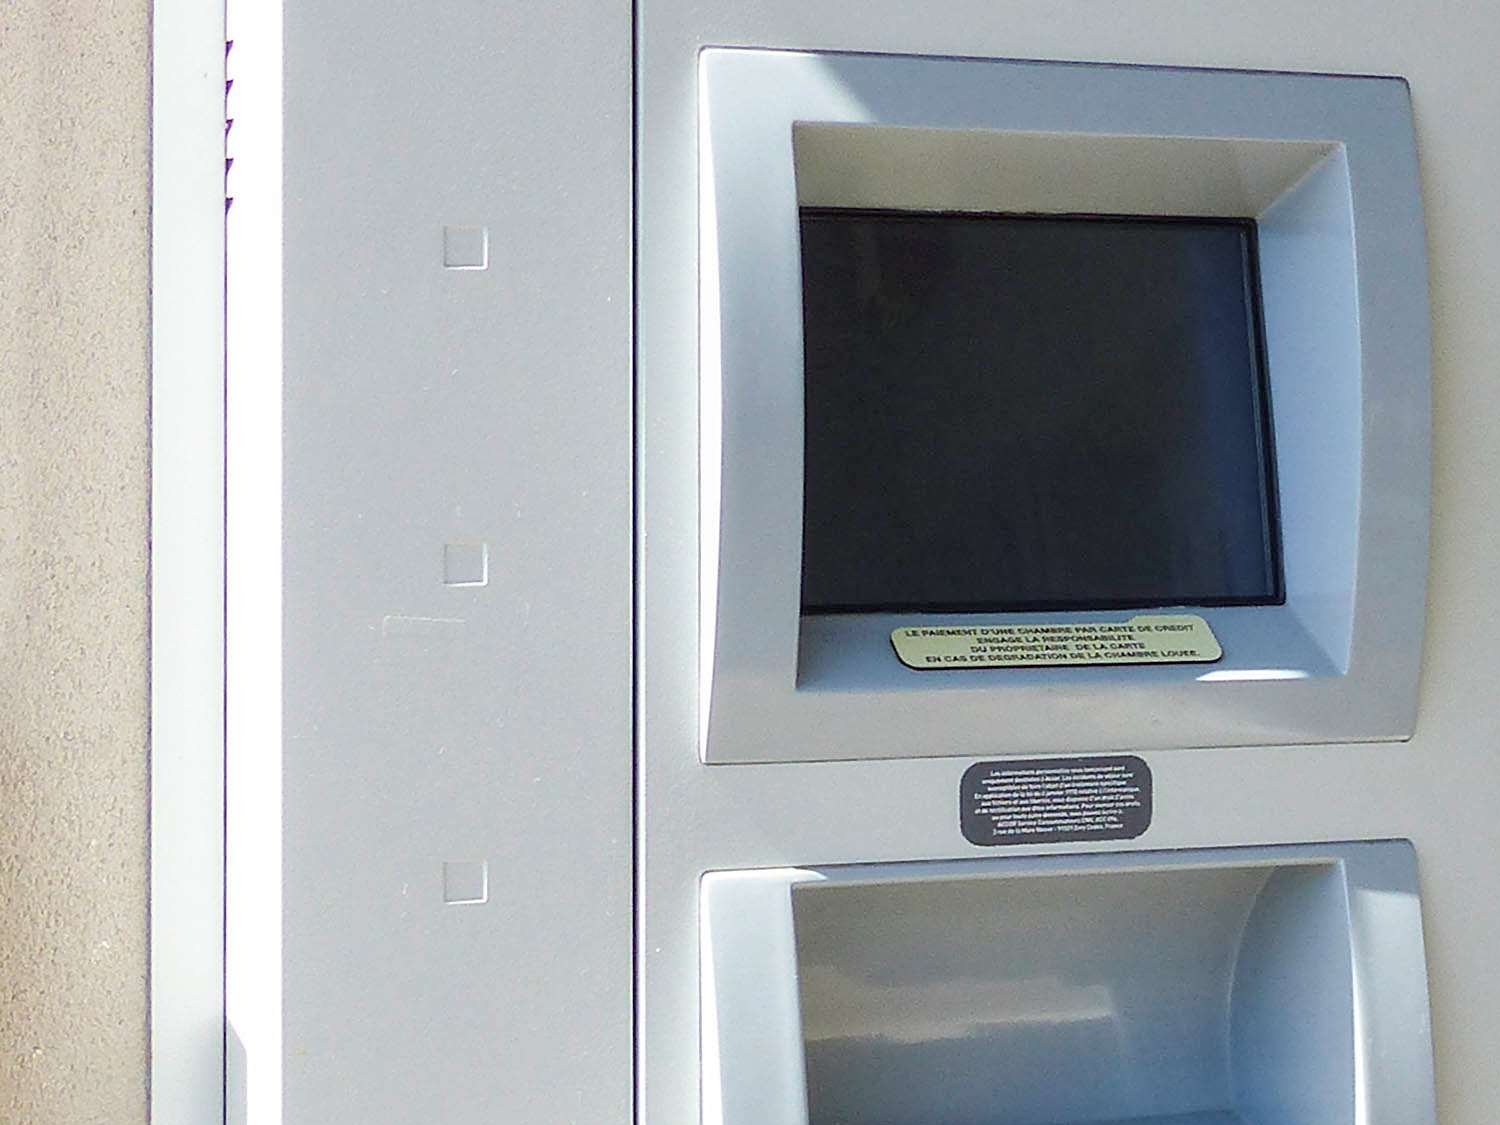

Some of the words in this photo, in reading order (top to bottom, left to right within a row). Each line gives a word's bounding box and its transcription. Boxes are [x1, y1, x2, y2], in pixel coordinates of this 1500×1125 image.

[905, 629, 921, 637] LE
[1100, 625, 1135, 633] CARTE
[943, 655, 967, 663] CAS
